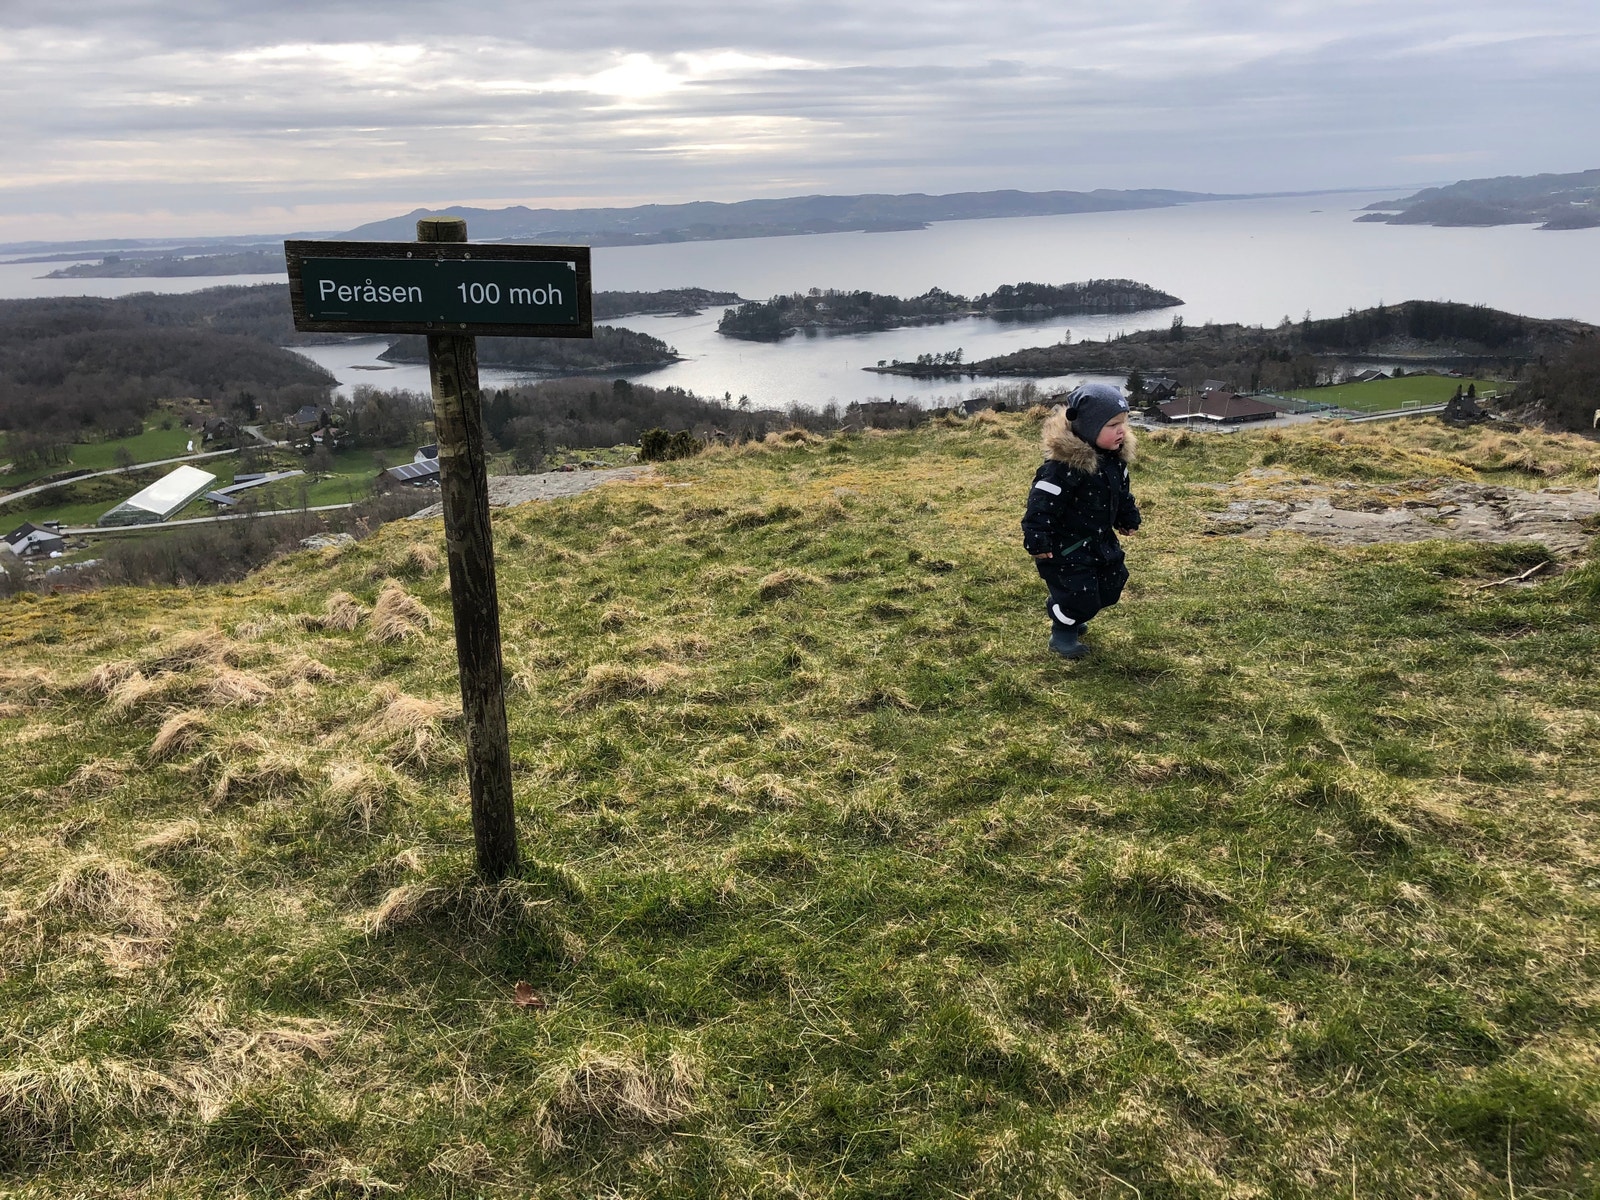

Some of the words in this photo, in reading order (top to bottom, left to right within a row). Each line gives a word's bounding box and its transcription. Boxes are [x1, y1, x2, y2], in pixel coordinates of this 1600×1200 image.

[318, 278, 423, 303] Peråsen
[457, 282, 501, 304] 100
[509, 283, 564, 305] moh
